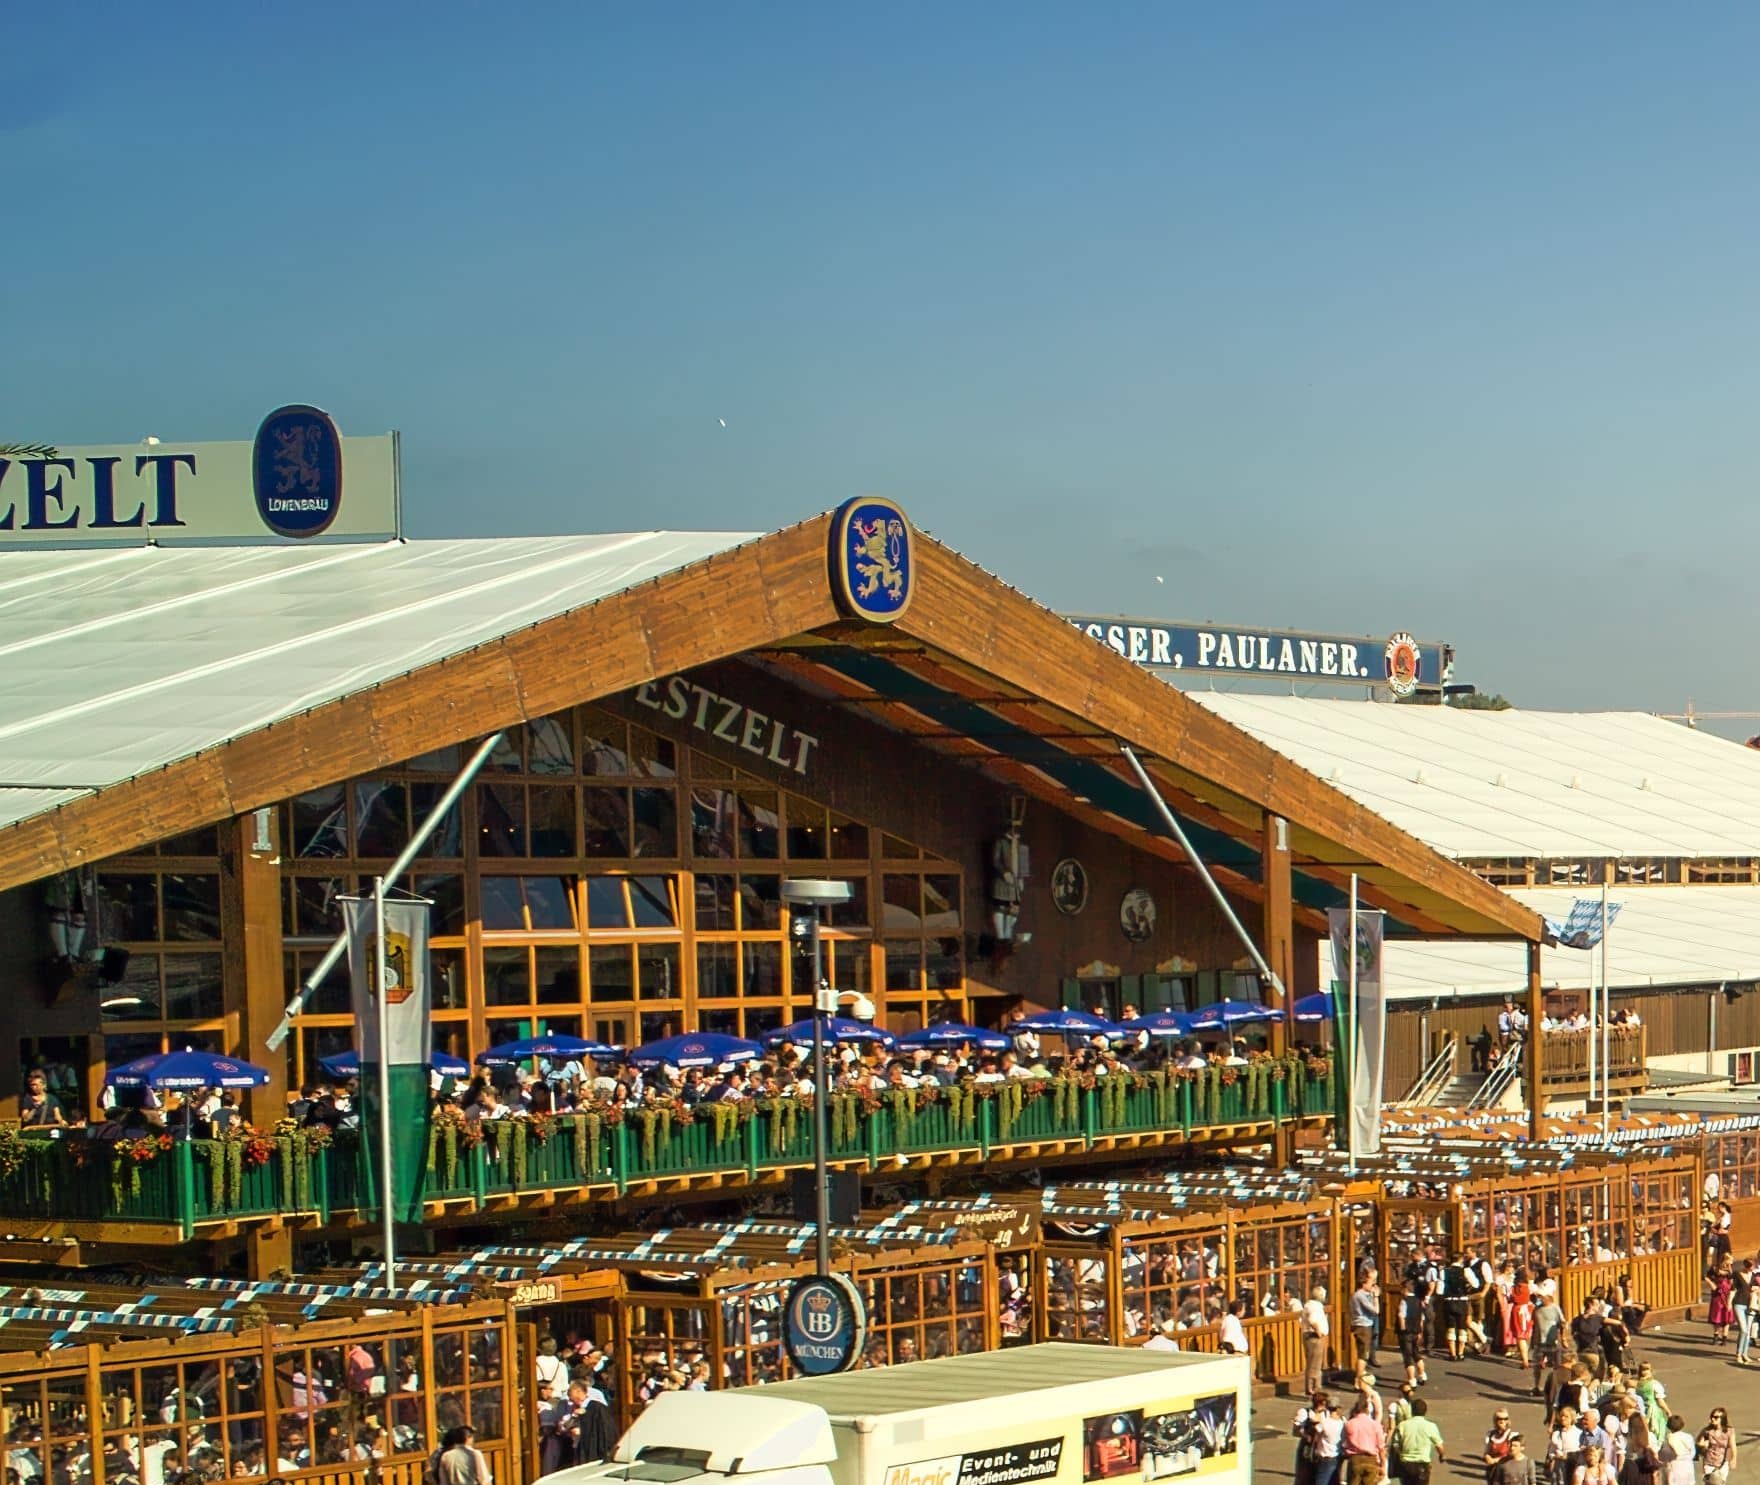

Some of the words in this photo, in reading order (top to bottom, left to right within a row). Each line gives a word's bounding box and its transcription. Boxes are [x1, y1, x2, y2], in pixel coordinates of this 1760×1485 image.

[0, 454, 197, 531] ELT
[1071, 622, 1184, 669] SSER,
[1197, 631, 1368, 678] PAULANER.
[808, 1311, 832, 1334] HB
[795, 1343, 844, 1360] MÜNCHEN
[962, 1453, 1019, 1473] Event-
[1029, 1442, 1061, 1460] und
